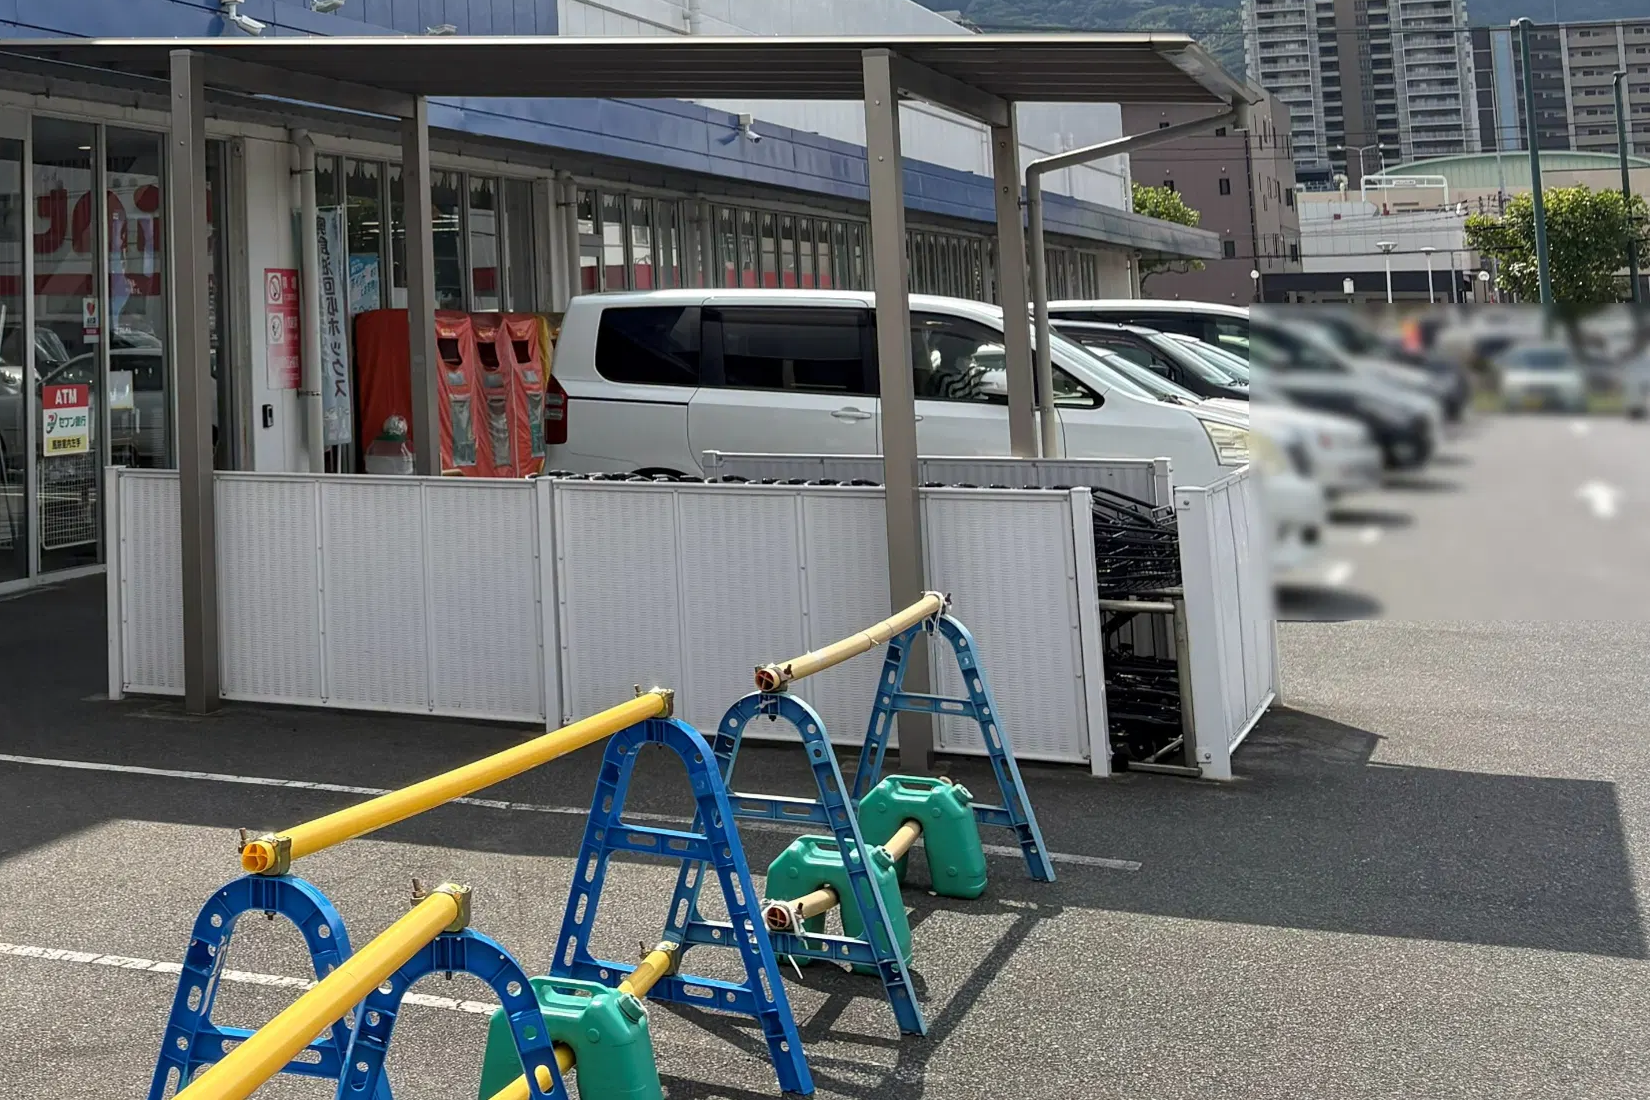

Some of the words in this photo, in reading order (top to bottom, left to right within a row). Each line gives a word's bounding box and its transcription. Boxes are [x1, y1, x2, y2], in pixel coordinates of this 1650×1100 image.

[55, 388, 77, 405] ATM
[59, 415, 86, 428] セブン銀行
